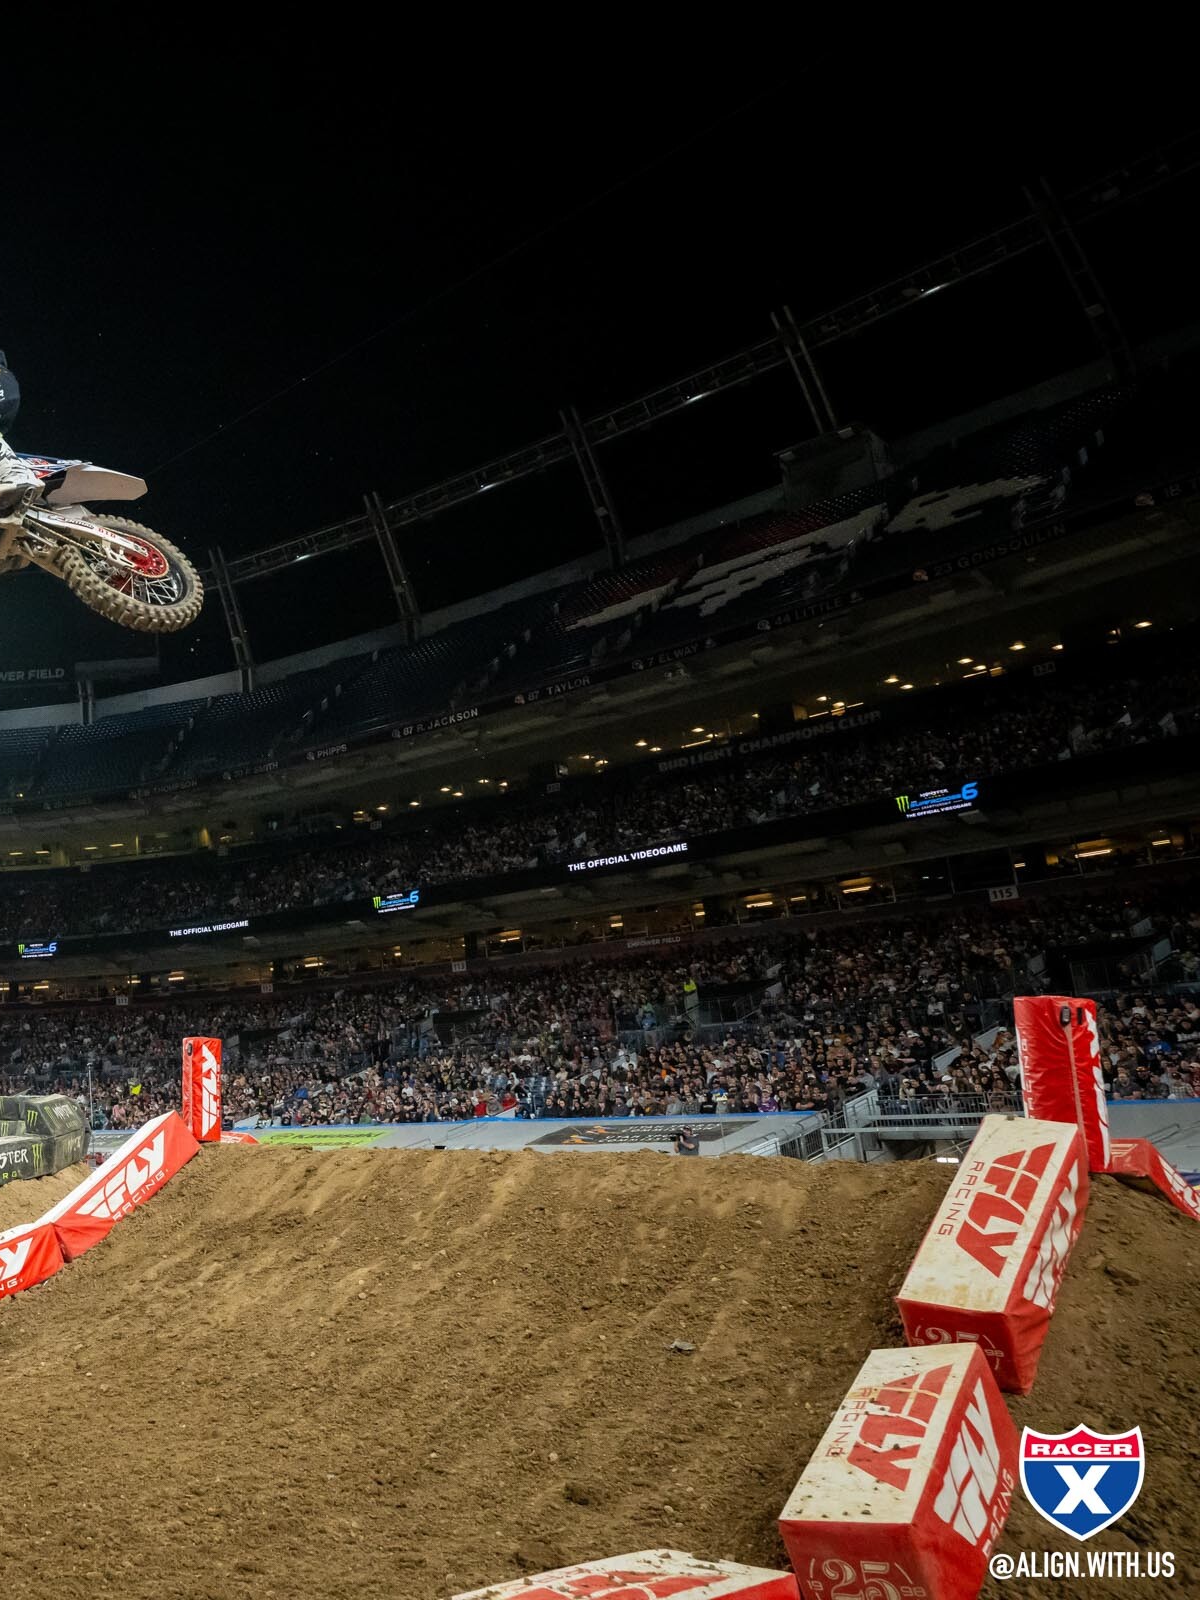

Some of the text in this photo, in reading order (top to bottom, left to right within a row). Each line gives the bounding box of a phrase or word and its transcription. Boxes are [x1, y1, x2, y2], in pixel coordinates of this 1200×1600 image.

[658, 642, 700, 663] ELWAY
[28, 667, 64, 680] FIELD
[546, 676, 590, 695] TAYLOR
[427, 708, 479, 729] JACKSON
[317, 744, 347, 759] PHIPPS
[658, 757, 688, 773] BUD
[690, 747, 734, 765] LIGHT
[739, 721, 835, 754] CHAMPIONS
[961, 781, 978, 801] 6
[567, 842, 688, 872] THE OFFICIAL VIDEOGAME
[410, 890, 419, 903] 6
[169, 920, 249, 937] THE OFFICIAL VIDEOGAME
[49, 942, 57, 952] 6
[662, 936, 681, 945] FIELD
[201, 1044, 218, 1137] FLY
[75, 1130, 165, 1218] FLY
[113, 1171, 165, 1222] RACING
[937, 1161, 984, 1236] RACING
[955, 1142, 1057, 1279] FLY
[847, 1364, 953, 1491] FLY
[934, 1378, 1000, 1546] FLY
